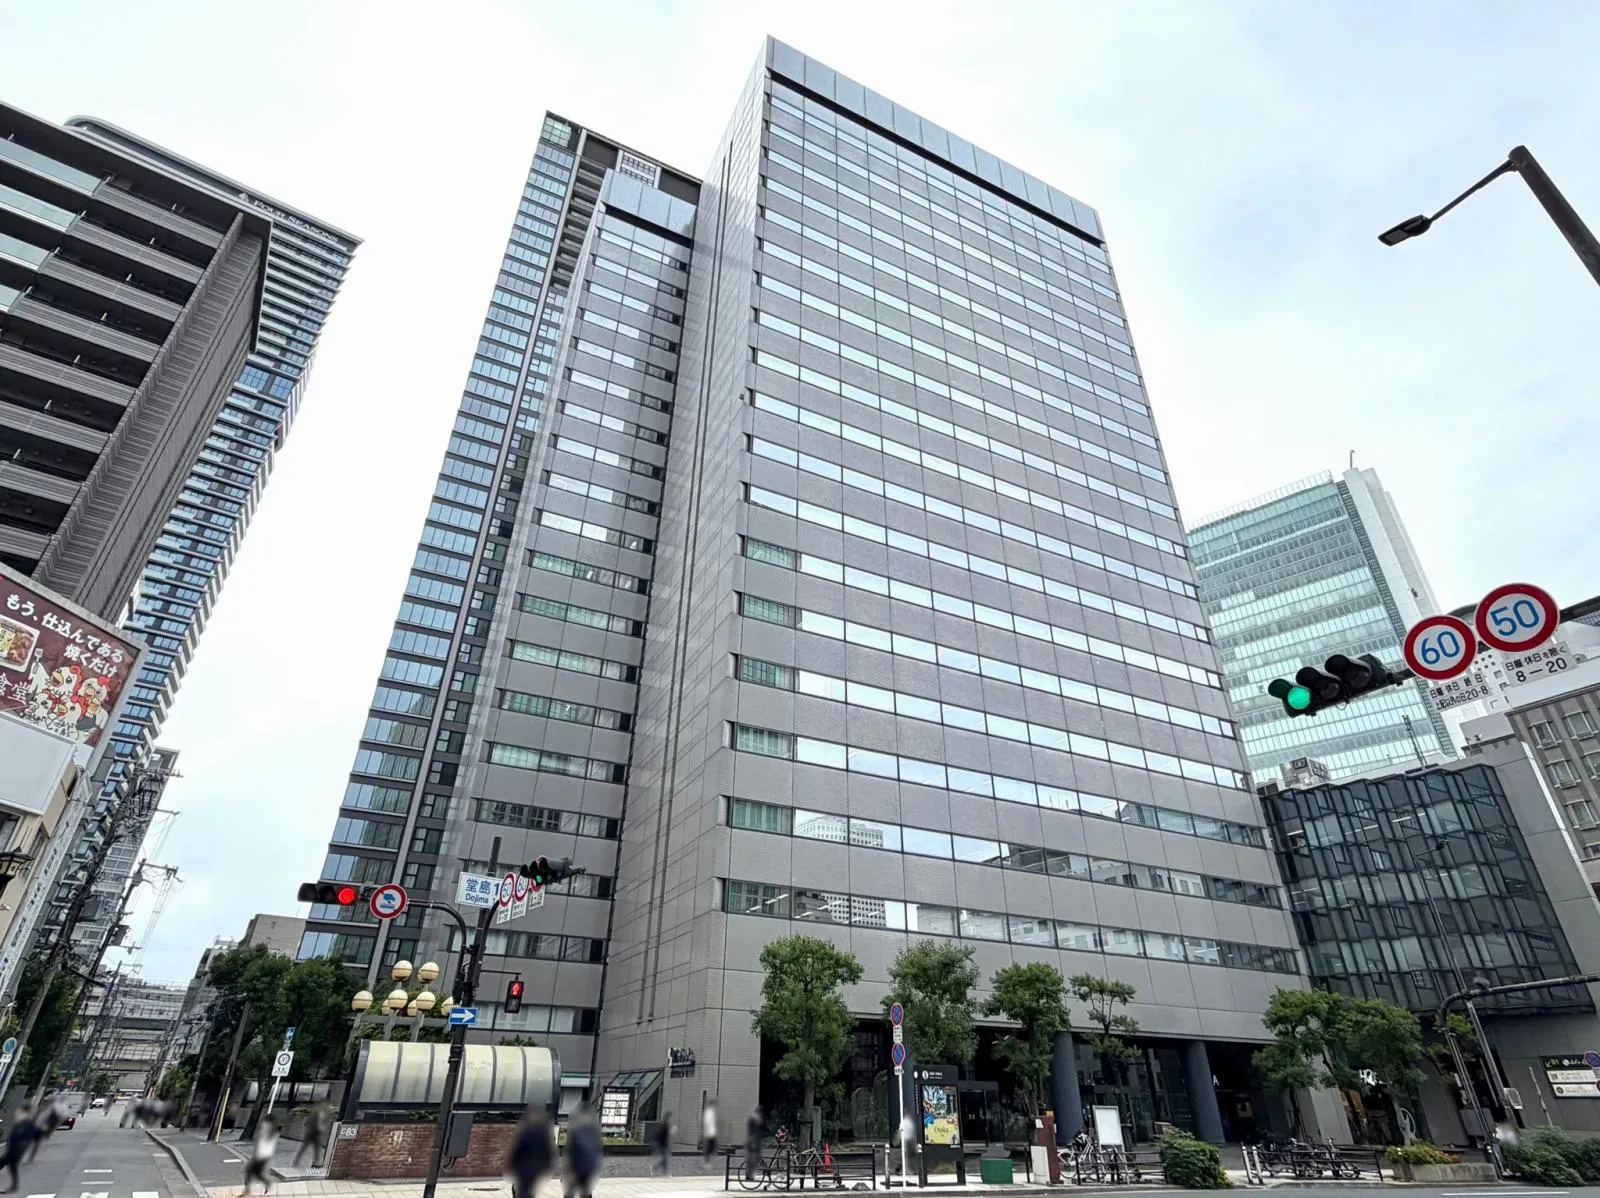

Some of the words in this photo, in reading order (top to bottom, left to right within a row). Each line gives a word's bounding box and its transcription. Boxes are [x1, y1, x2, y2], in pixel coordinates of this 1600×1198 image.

[6, 593, 123, 664] もう、仕込んである
[1490, 599, 1540, 637] 50
[63, 643, 118, 677] 焼くだけ
[1420, 630, 1460, 665] 60
[465, 893, 489, 904] Dojima
